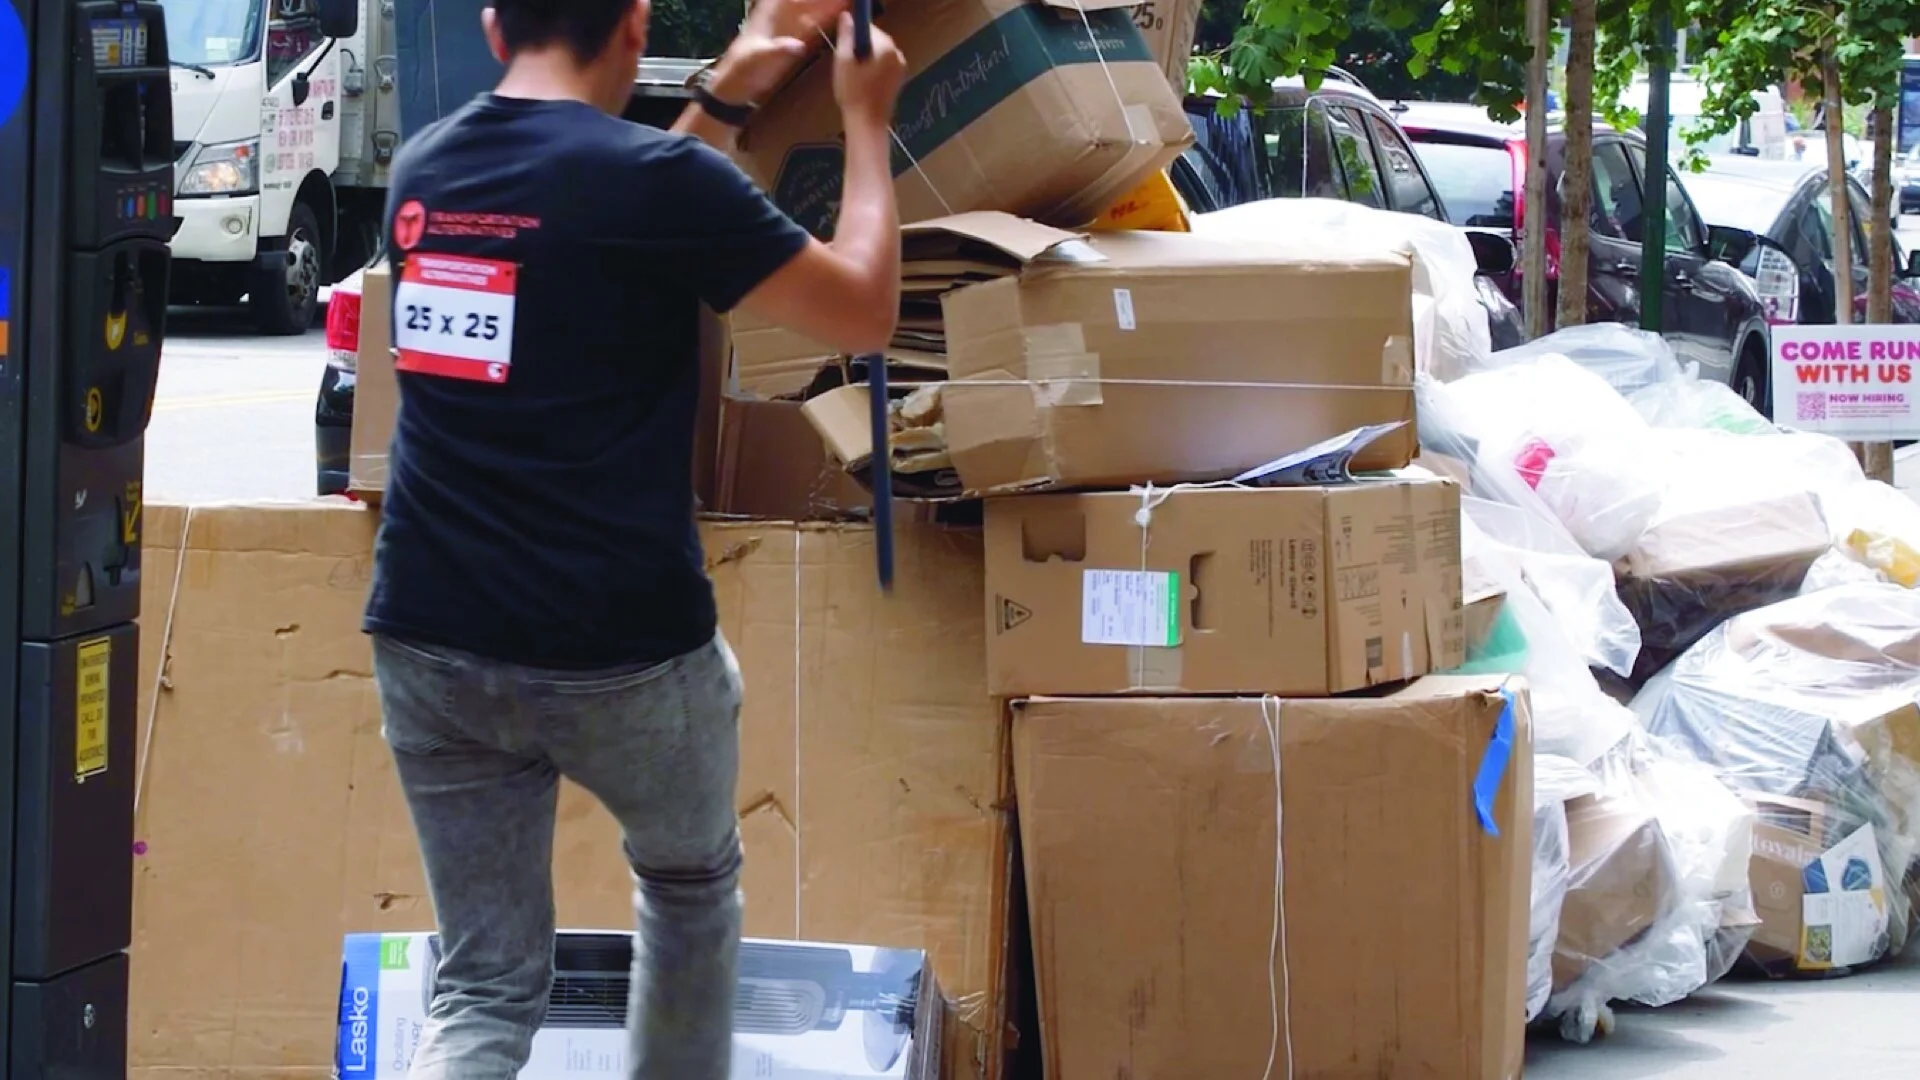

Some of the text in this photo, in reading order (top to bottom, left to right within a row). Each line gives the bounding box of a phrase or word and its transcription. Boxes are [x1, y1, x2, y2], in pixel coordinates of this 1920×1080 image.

[406, 305, 499, 341] 25 x 25
[1780, 341, 1920, 361] COME RUN
[1796, 364, 1912, 384] WITH US
[1829, 393, 1905, 404] NOW HIRING
[345, 985, 369, 1072] Lasko
